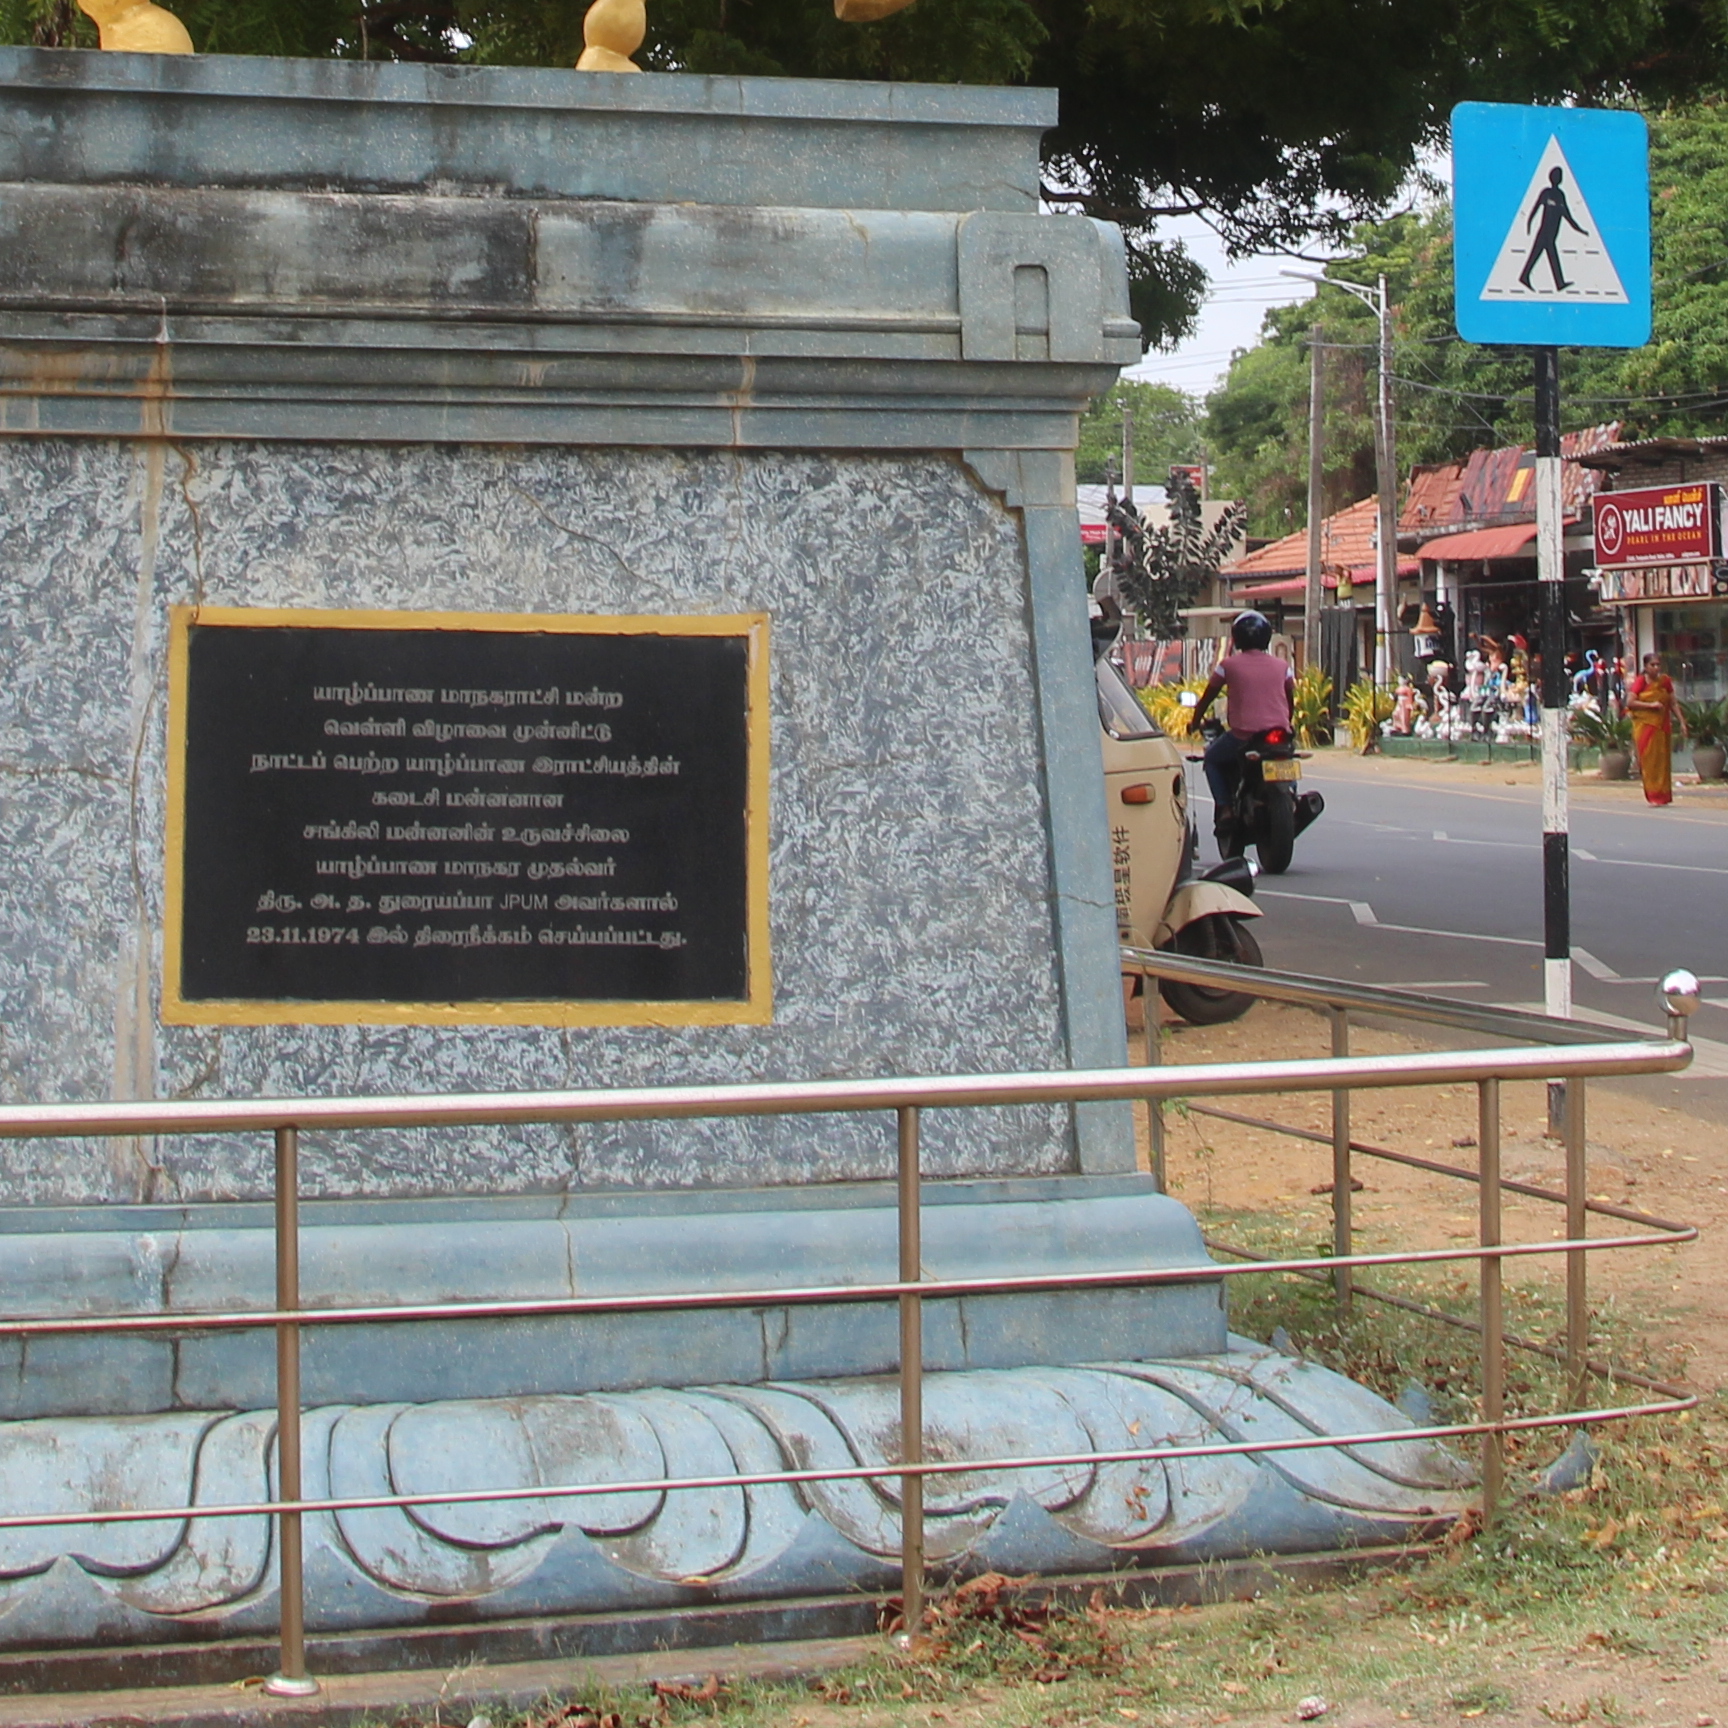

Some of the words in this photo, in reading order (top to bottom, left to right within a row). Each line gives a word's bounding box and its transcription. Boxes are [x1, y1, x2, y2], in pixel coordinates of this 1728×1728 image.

[1623, 507, 1653, 533] YALI
[1655, 502, 1703, 531] FANCY
[1627, 534, 1648, 545] PEARL
[1651, 533, 1660, 544] IN
[1662, 532, 1676, 543] THE
[1677, 530, 1702, 541] OCEAN
[313, 681, 435, 706] யாழ்ப்பாண
[440, 686, 560, 709] மாநகராட்சி
[565, 685, 624, 710] மன்ற
[323, 716, 407, 737] வெள்ளி
[411, 718, 507, 743] விழாவை
[512, 719, 613, 744] முன்னிட்டு
[249, 749, 327, 774] நாட்டப்
[333, 750, 400, 775] பெற்ற
[405, 752, 526, 777] யாழ்ப்பாண
[531, 754, 681, 778] இராட்சியத்தின்
[371, 787, 440, 807] கடைசி
[445, 788, 564, 808] மன்னனான
[302, 819, 380, 841] சங்கிலி
[385, 820, 496, 842] மன்னனின்
[501, 822, 630, 847] உருவச்சிலை
[316, 854, 438, 880] யாழ்ப்பாண
[444, 860, 522, 880] மாநகர
[526, 856, 617, 881] முதல்வர்
[499, 893, 548, 910] JPUM
[554, 890, 679, 912] அவர்களால்
[246, 926, 360, 944] 23.11.1974
[366, 923, 409, 944] இல்
